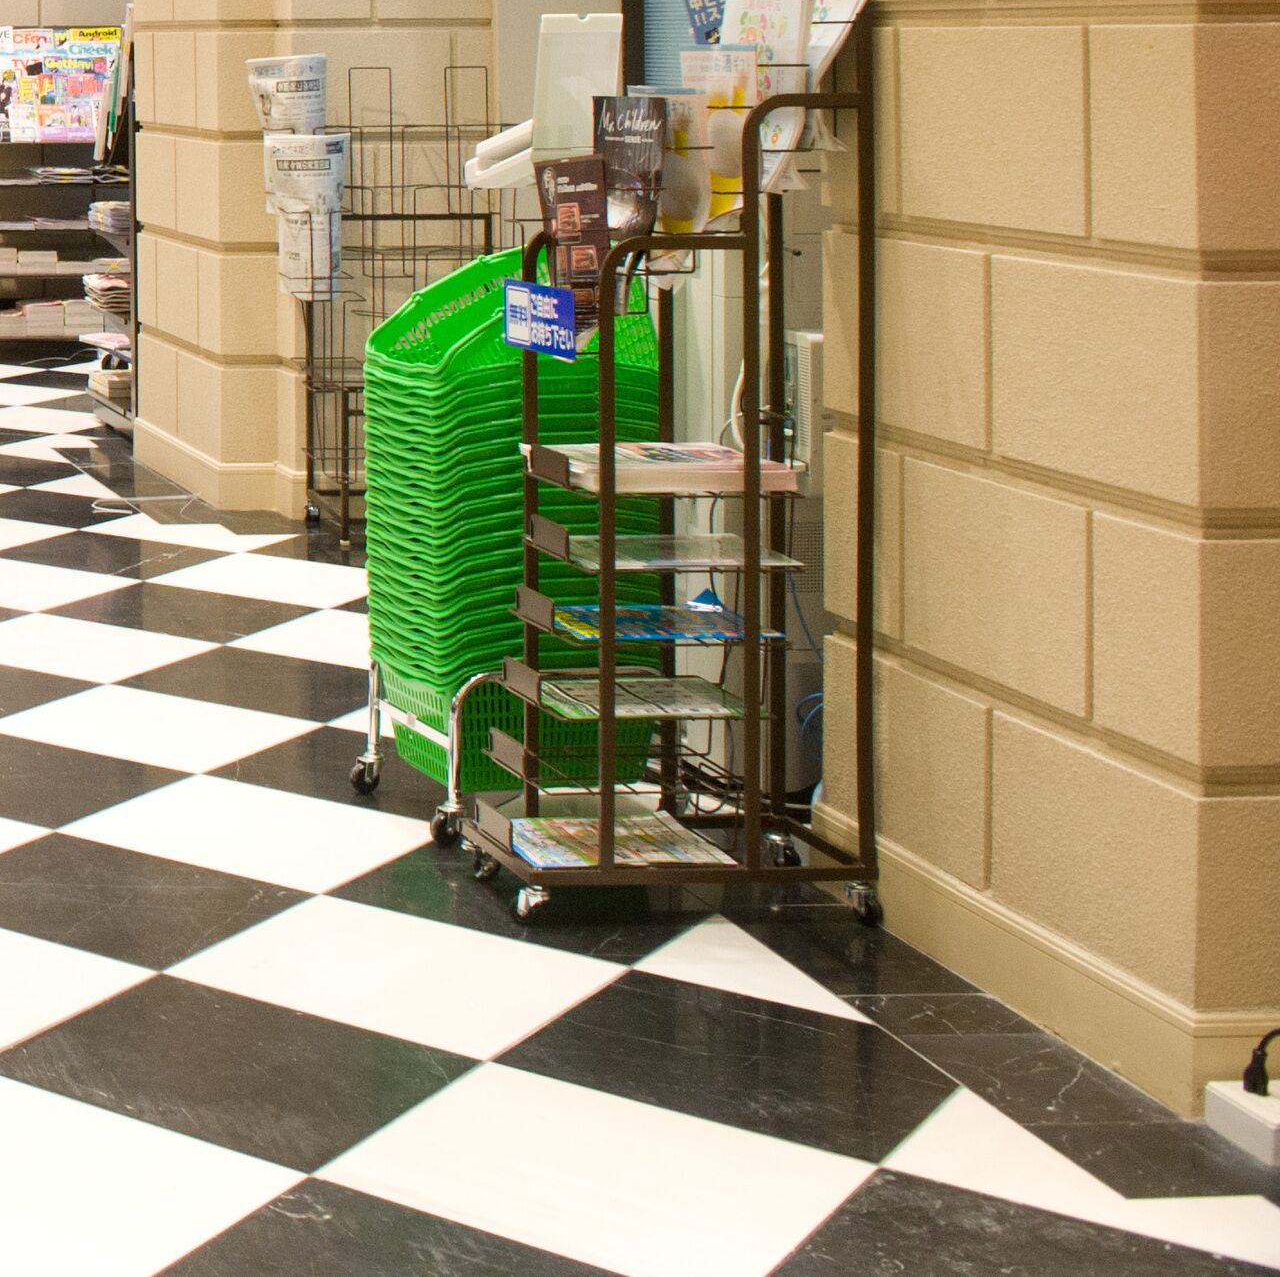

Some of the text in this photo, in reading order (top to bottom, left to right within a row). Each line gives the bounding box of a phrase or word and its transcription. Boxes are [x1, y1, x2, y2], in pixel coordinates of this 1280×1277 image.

[78, 28, 117, 38] Android
[531, 293, 559, 320] ご自由に
[531, 321, 575, 351] お持ち下さい
